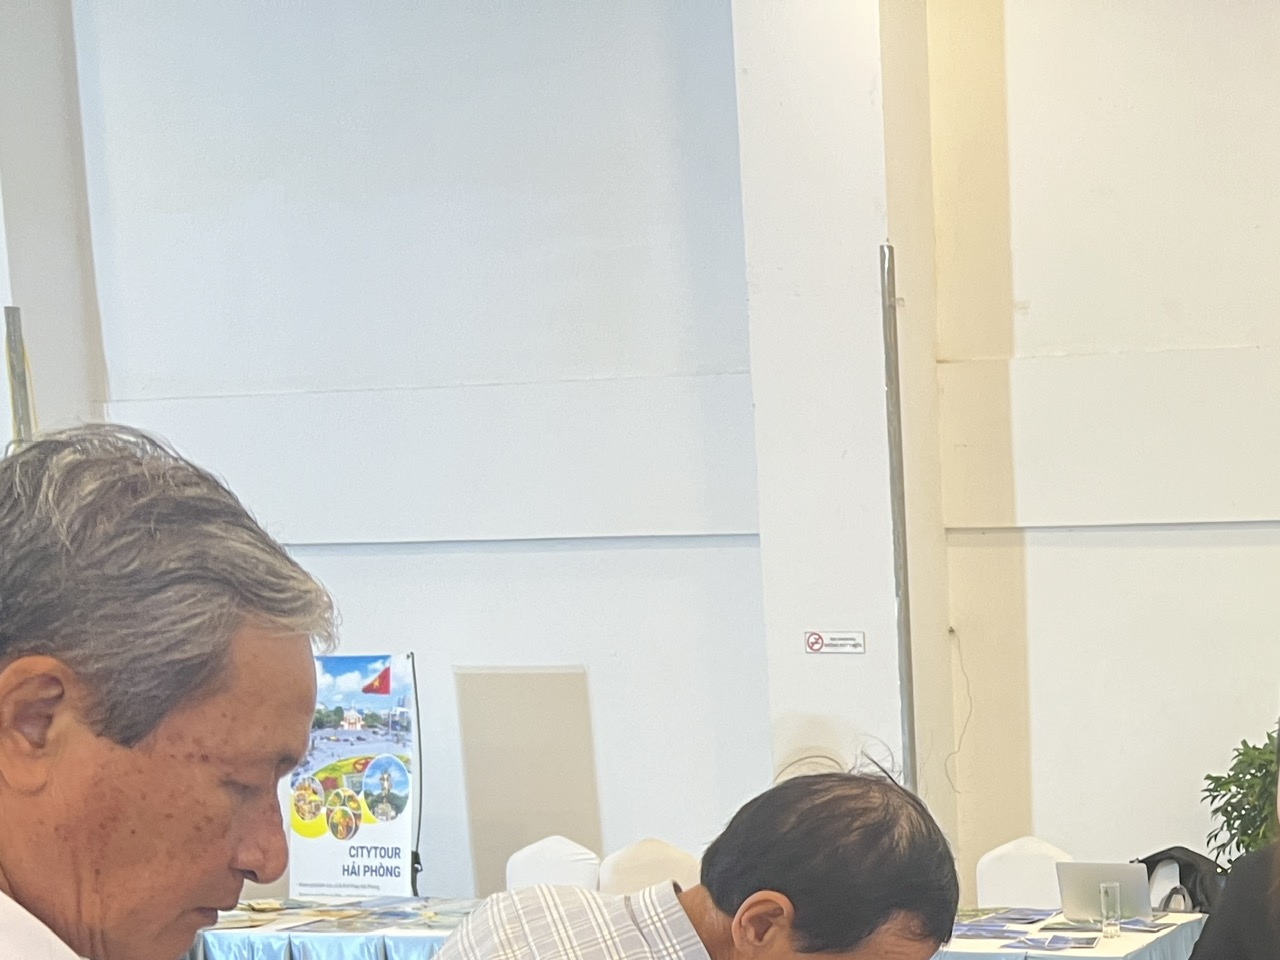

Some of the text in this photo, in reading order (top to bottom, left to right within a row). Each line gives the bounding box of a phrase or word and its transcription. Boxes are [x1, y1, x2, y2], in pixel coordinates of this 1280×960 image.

[348, 845, 401, 859] CITYTOUR
[342, 861, 401, 878] HẢI PHÒNG
